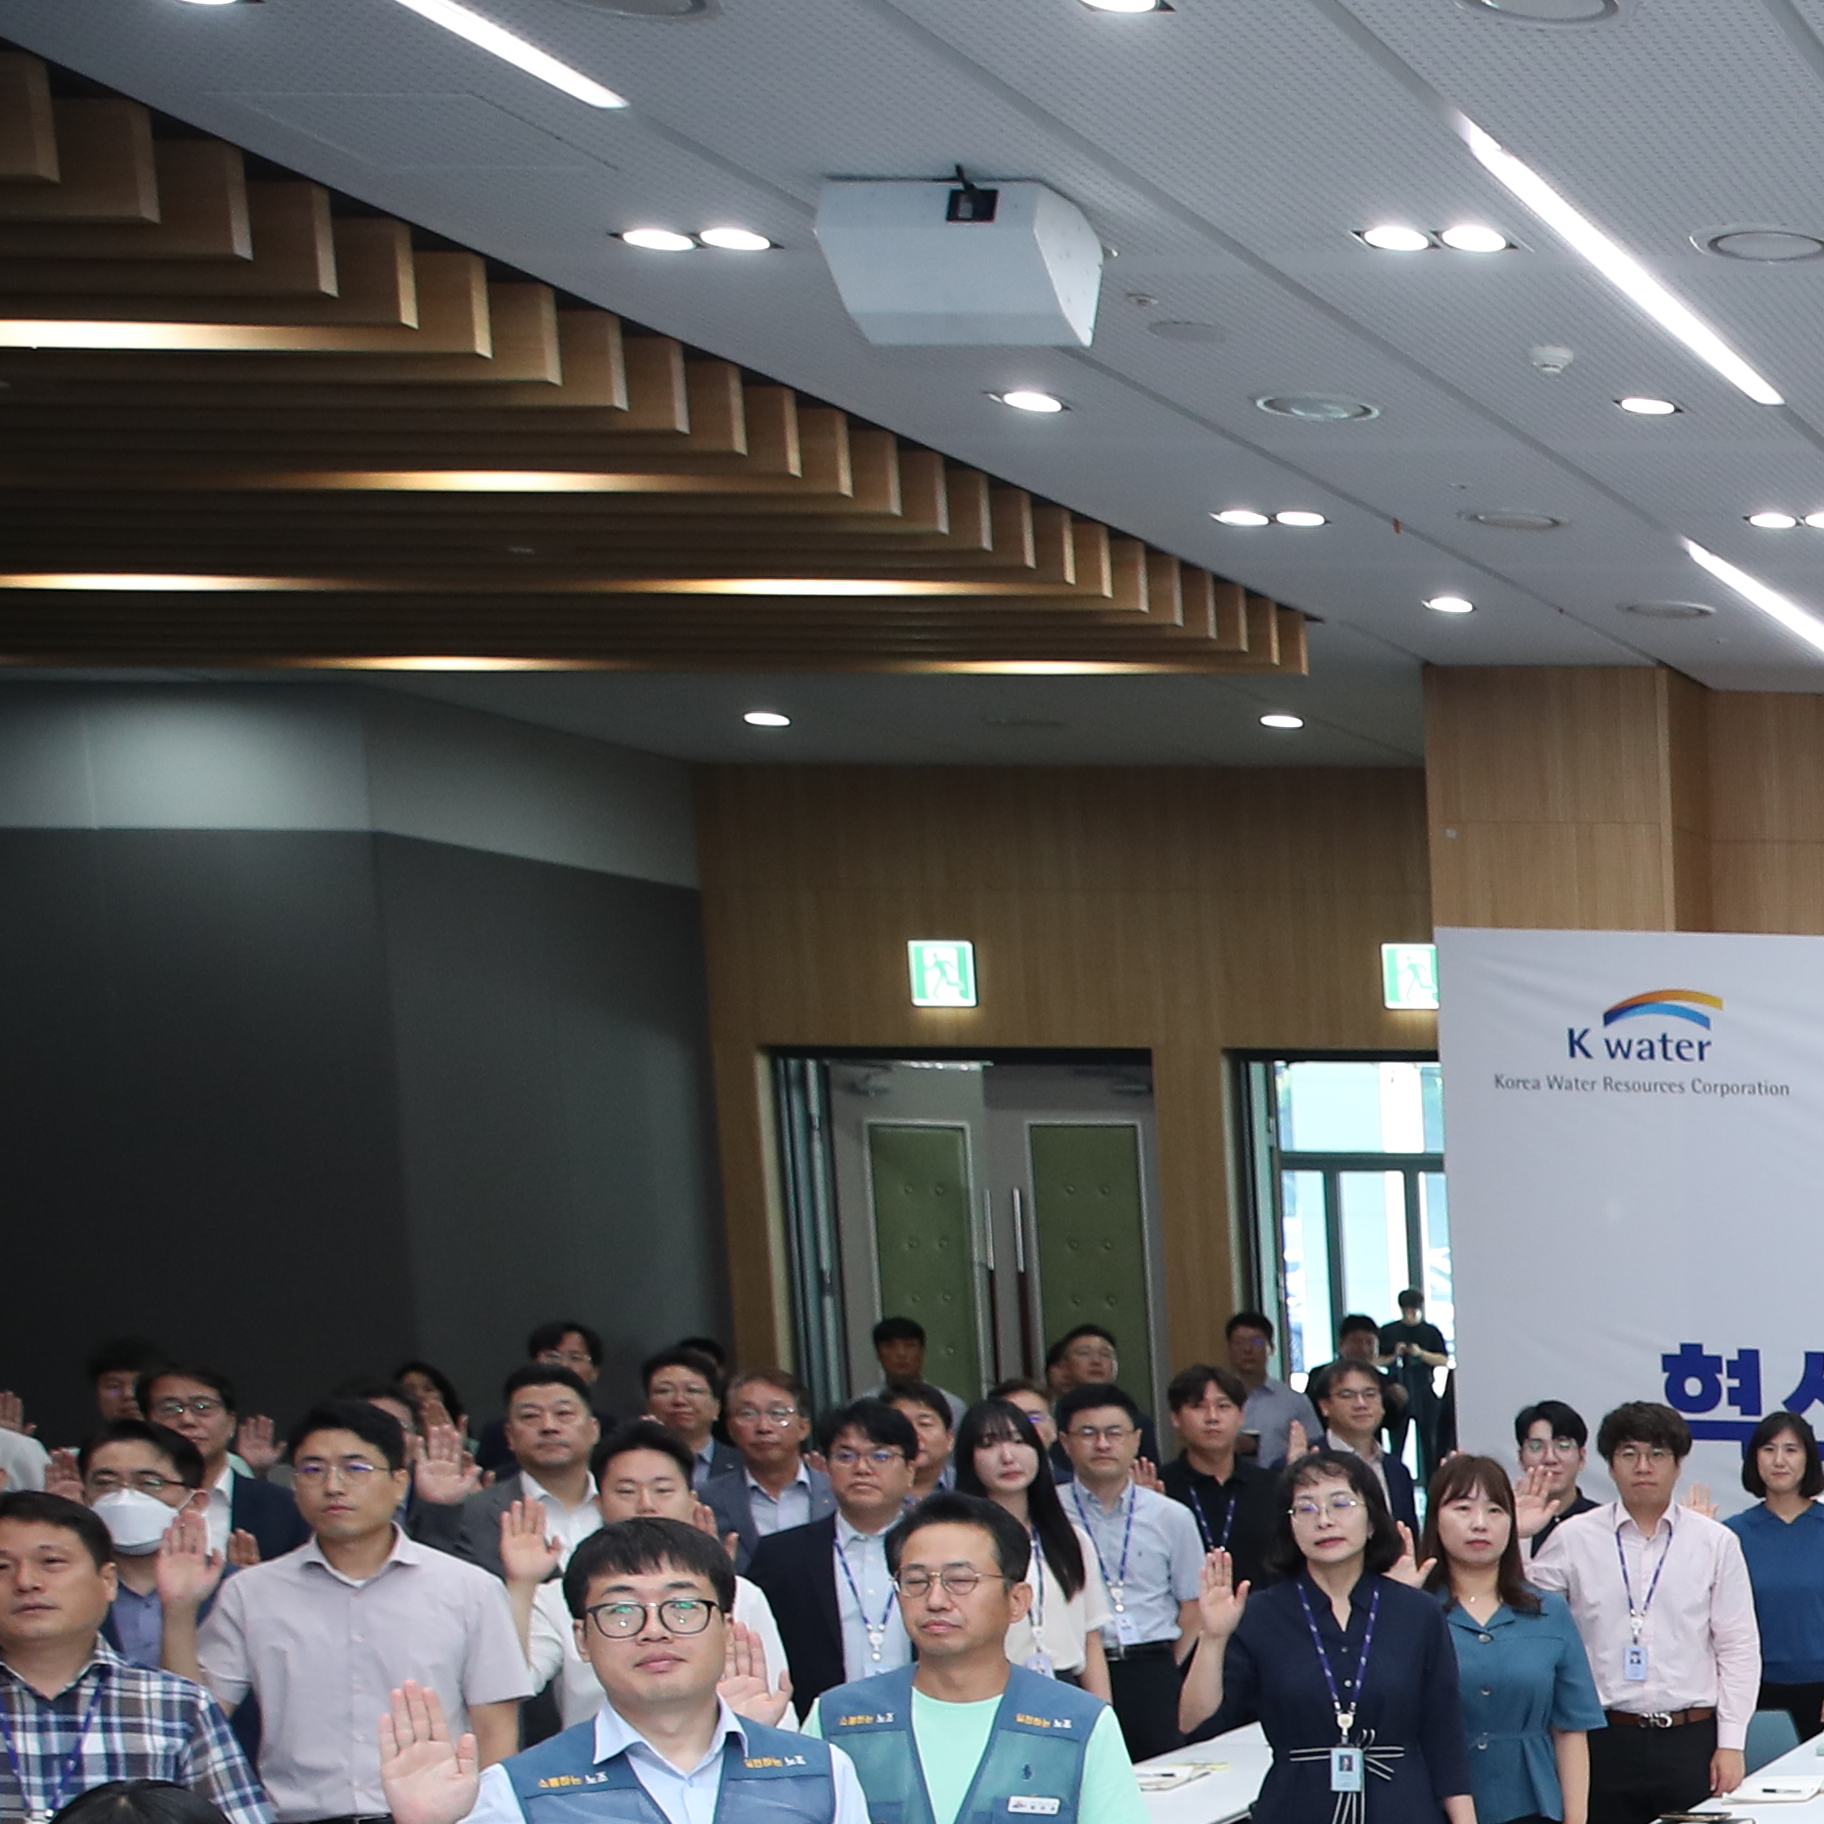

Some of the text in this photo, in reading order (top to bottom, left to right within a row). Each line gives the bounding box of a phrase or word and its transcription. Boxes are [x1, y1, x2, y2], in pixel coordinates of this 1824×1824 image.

[1567, 1026, 1712, 1063] K water
[1493, 1073, 1790, 1099] Korea Water Resources Corporation
